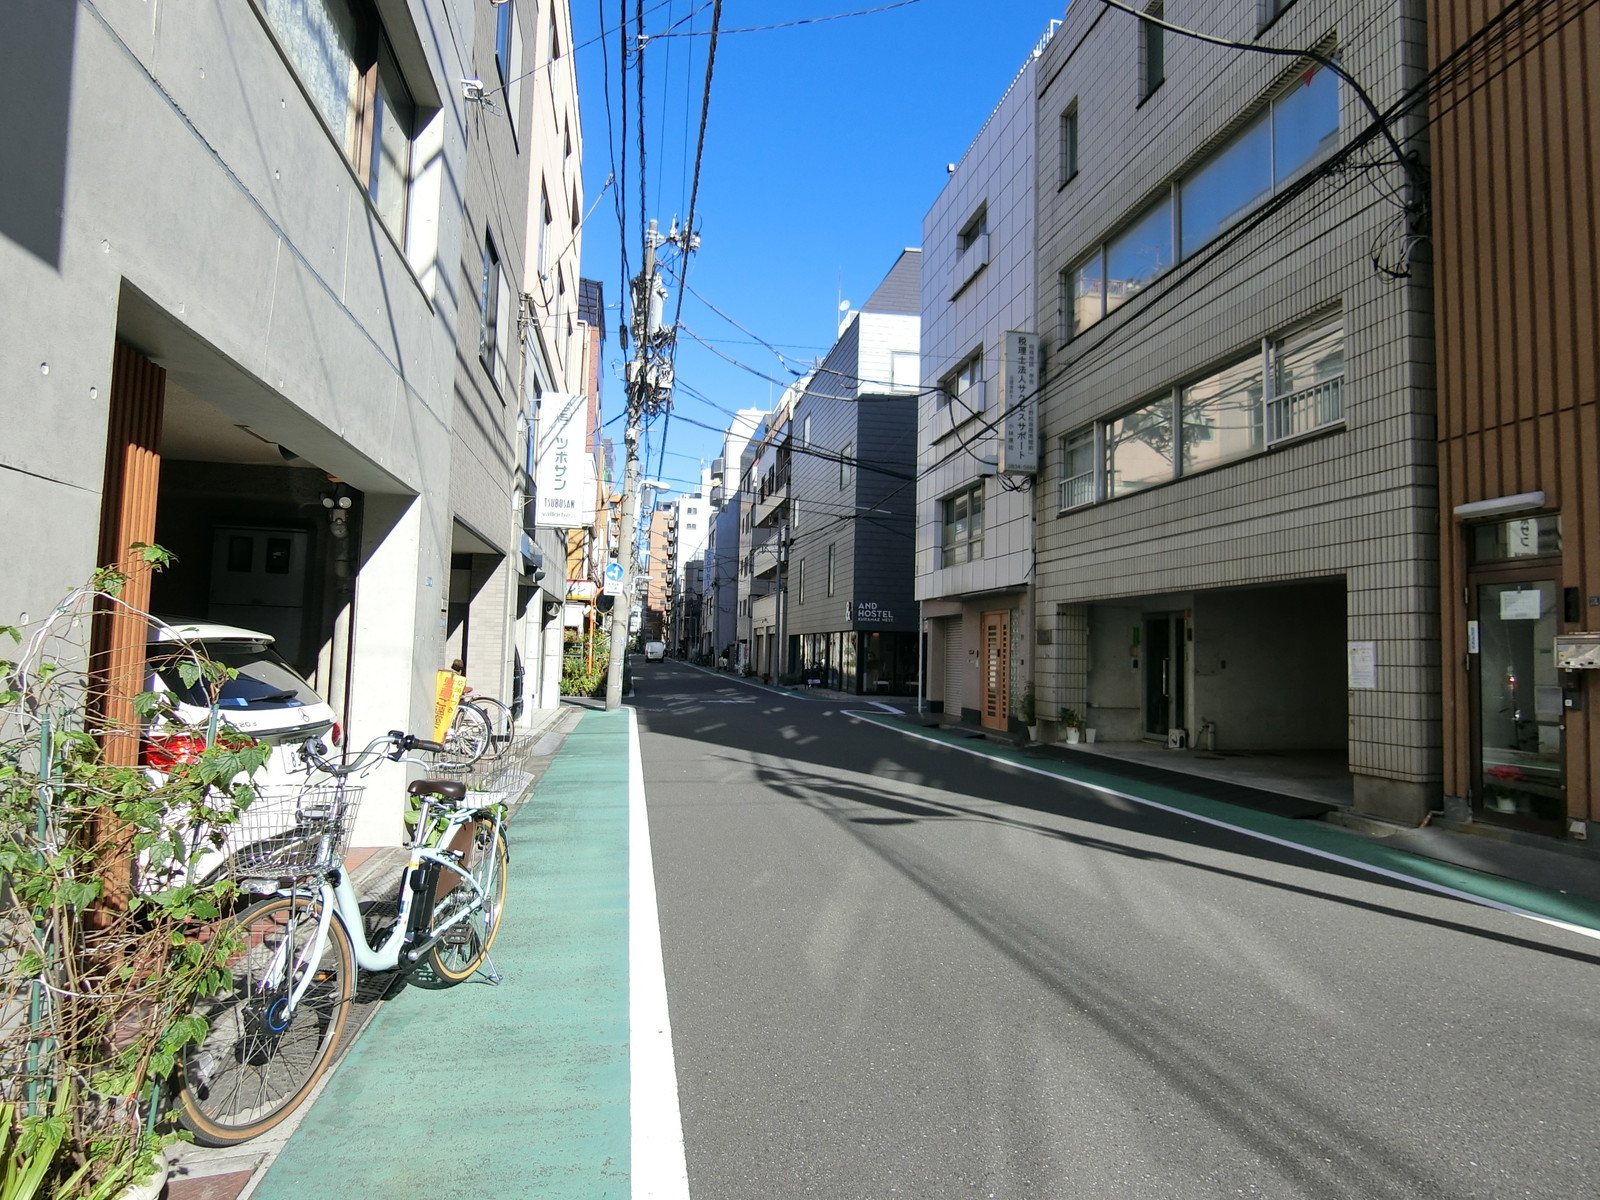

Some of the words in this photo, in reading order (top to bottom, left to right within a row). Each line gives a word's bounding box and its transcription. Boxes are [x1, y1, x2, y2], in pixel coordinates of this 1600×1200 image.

[1017, 336, 1027, 460] 税理士法人サクセスサポート
[554, 437, 569, 491] ツボサン
[544, 497, 575, 509] TSUBOSAN
[858, 609, 894, 618] HOSTEL
